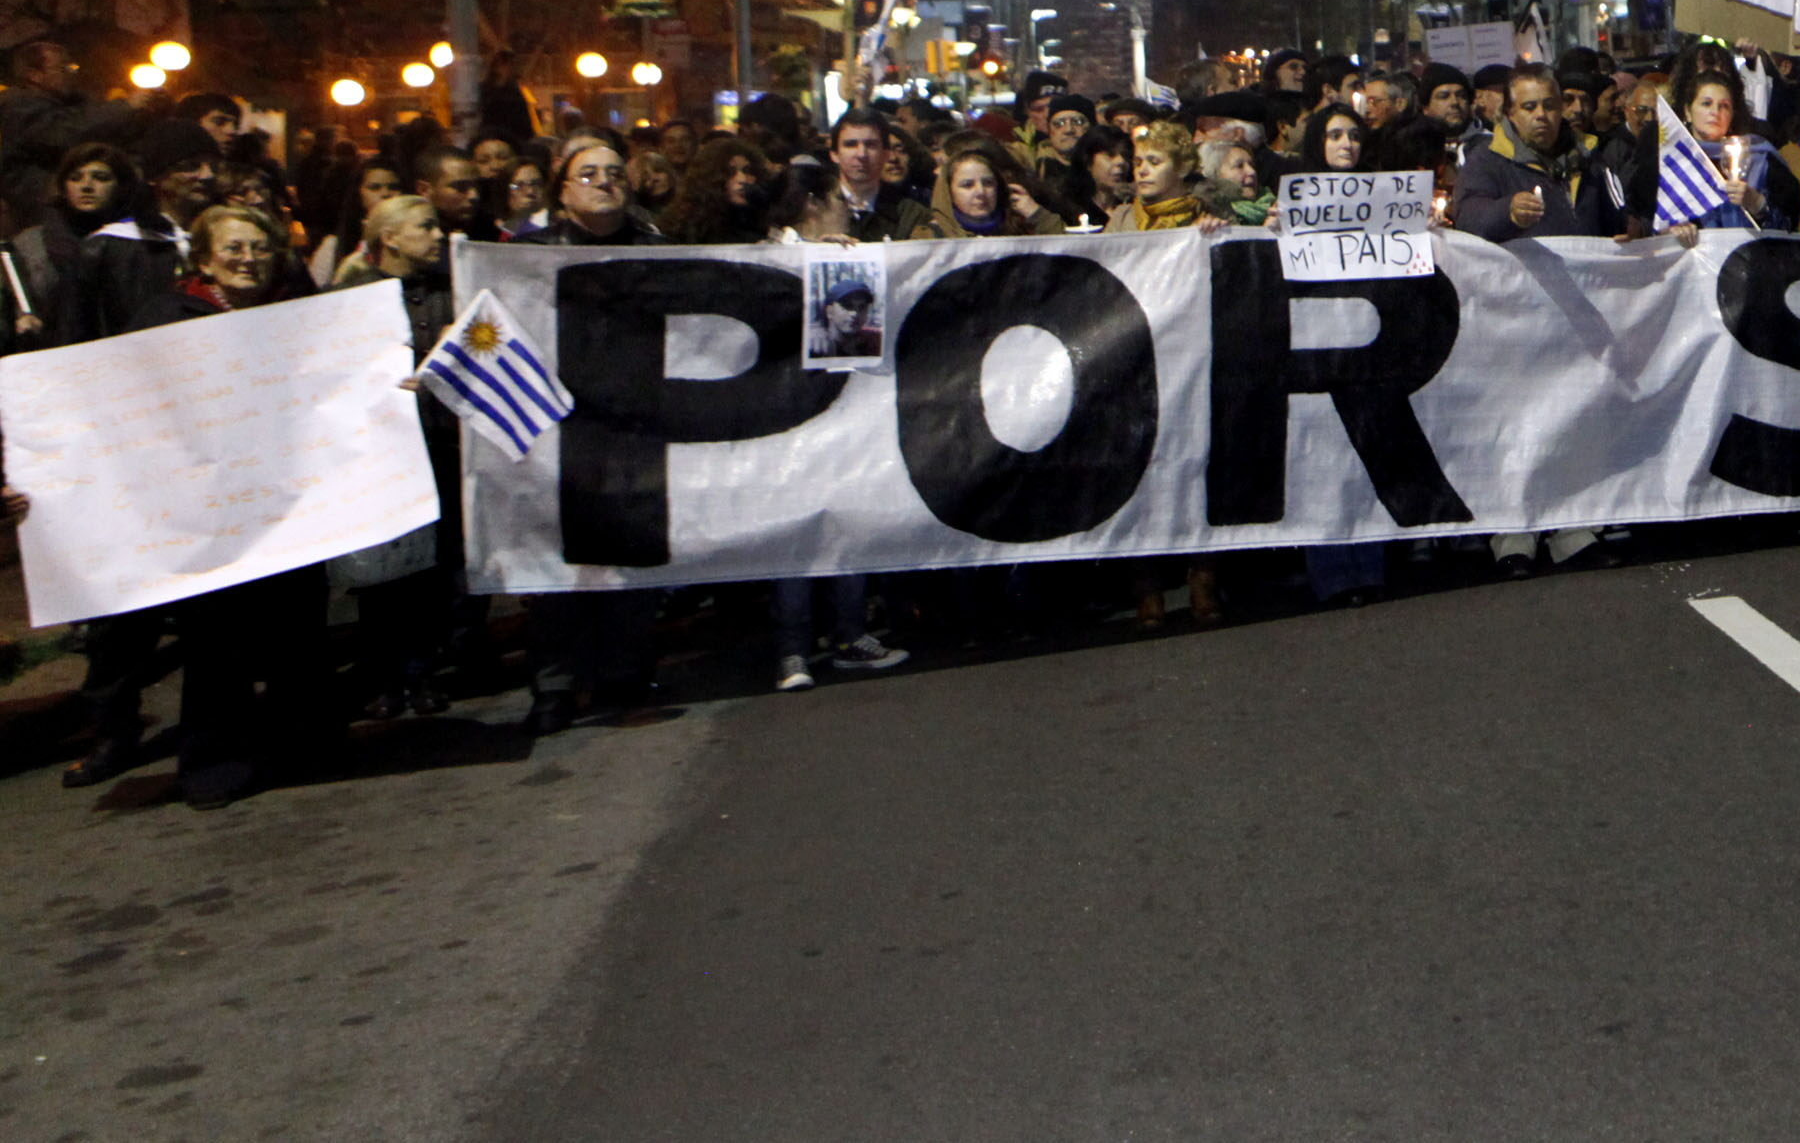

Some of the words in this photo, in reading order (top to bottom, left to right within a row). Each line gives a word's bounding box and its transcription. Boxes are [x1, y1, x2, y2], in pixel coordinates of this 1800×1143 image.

[1288, 176, 1376, 201] ESTOY
[1392, 175, 1416, 194] DE
[1288, 202, 1372, 228] DUELO
[1384, 201, 1425, 220] POR
[557, 239, 1474, 567] POR
